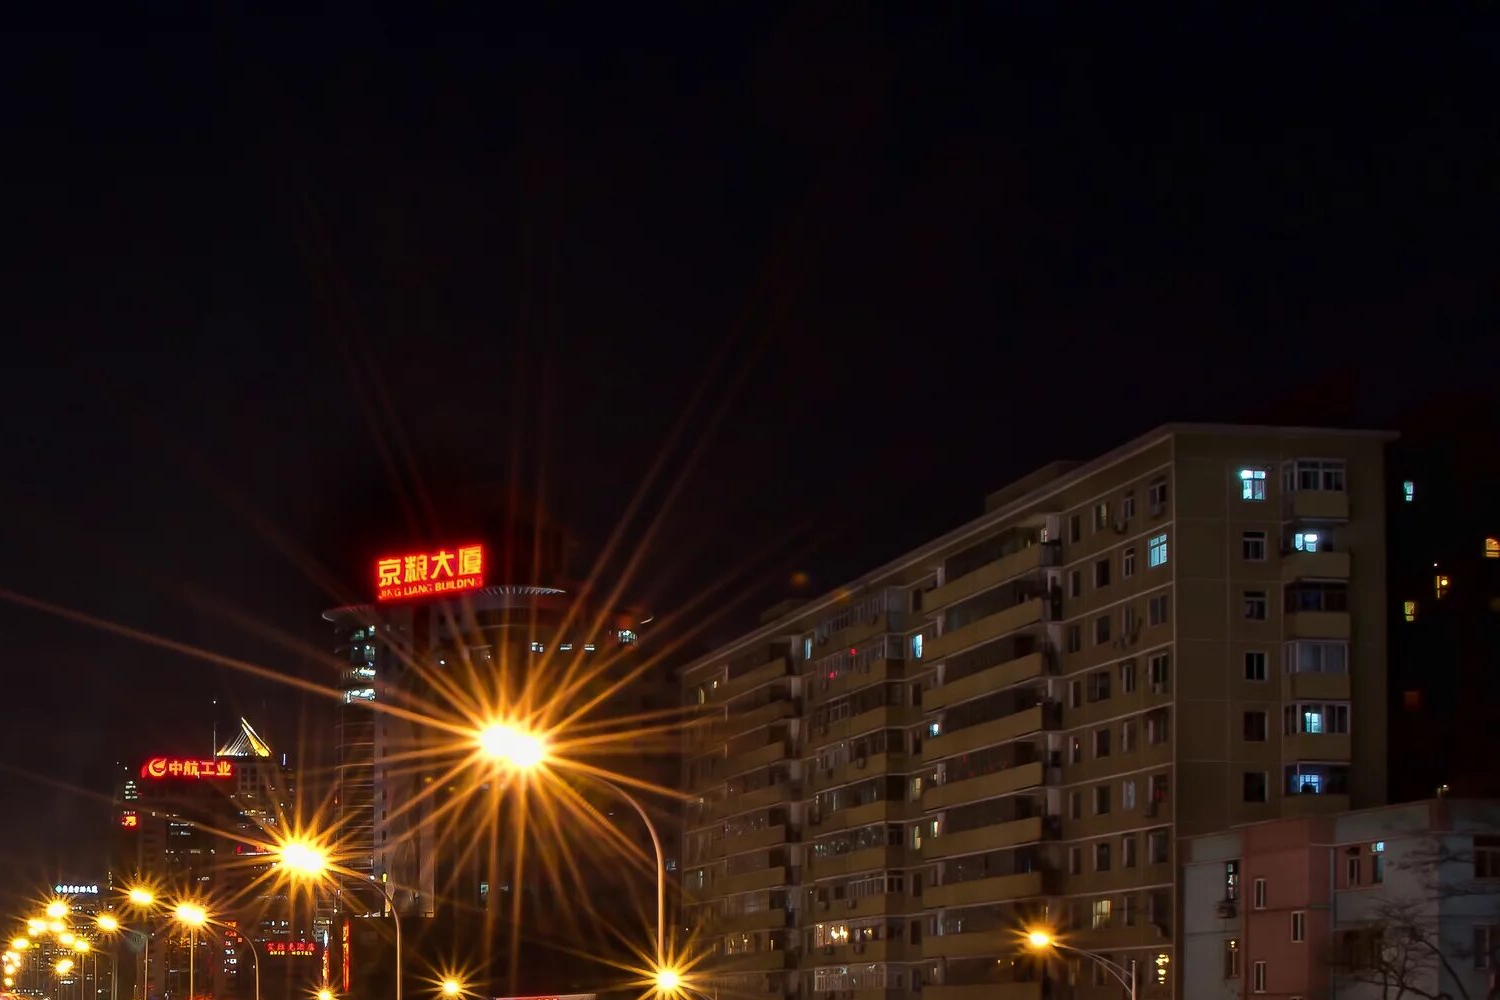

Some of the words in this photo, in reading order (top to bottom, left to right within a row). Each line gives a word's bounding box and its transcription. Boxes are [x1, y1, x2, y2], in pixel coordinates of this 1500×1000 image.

[378, 546, 482, 587] 京粮大厦
[404, 584, 433, 596] LIANG
[168, 760, 232, 776] 中航工业
